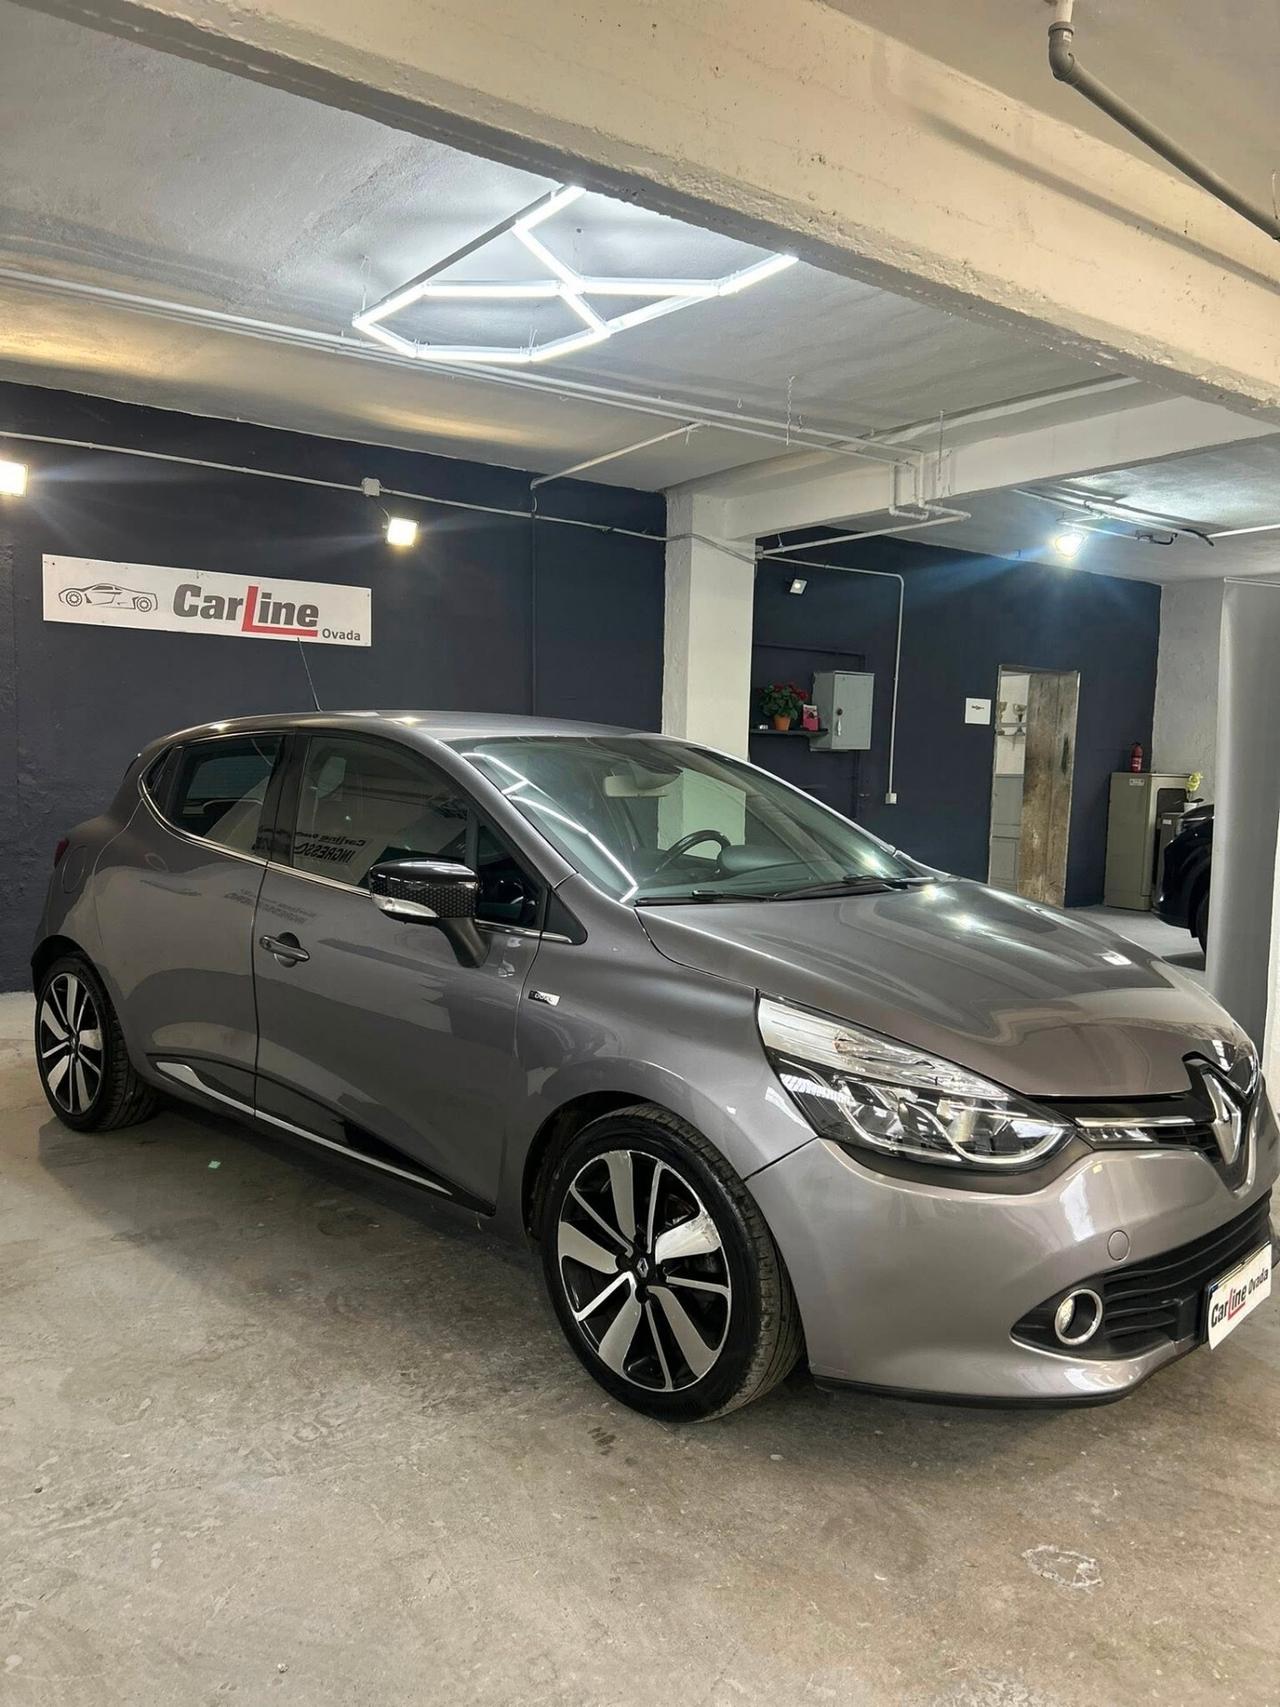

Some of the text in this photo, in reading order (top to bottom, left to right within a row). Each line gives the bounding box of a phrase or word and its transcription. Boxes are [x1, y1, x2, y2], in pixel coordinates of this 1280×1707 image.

[172, 583, 361, 642] CarLine Ovada
[1211, 1268, 1269, 1328] CarLine Ovada
